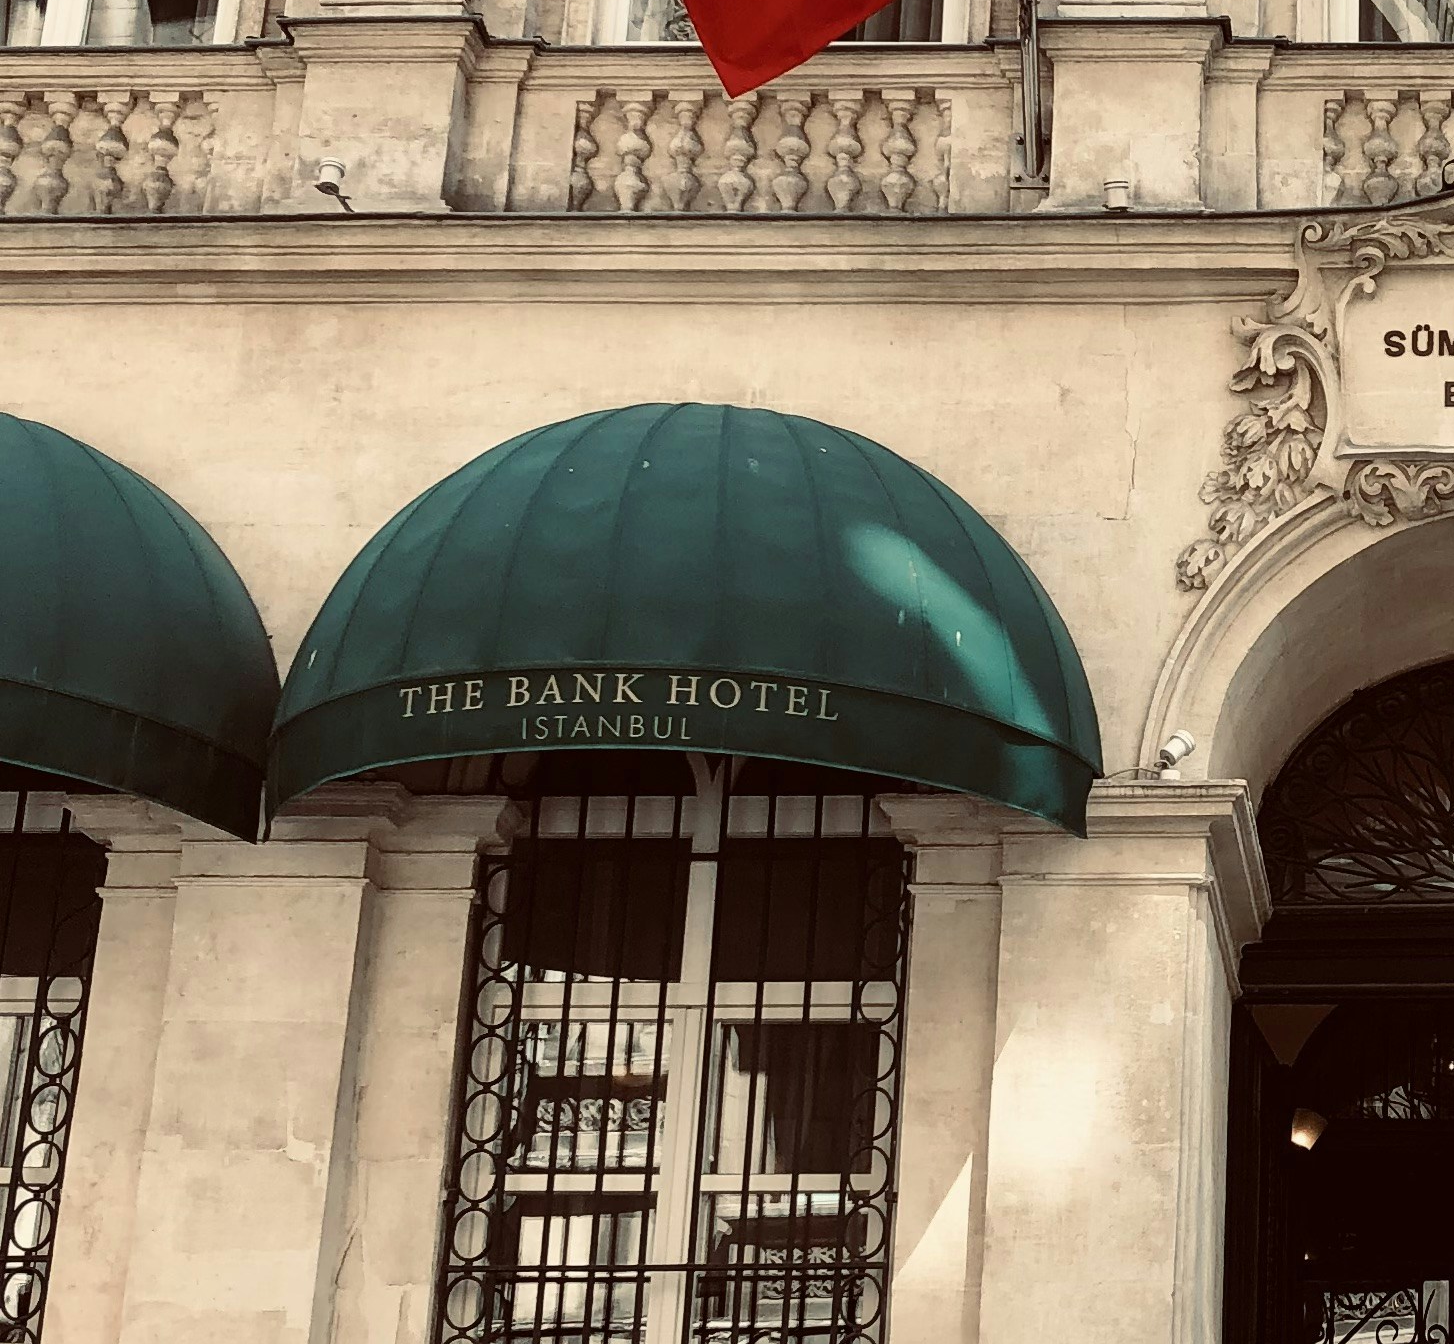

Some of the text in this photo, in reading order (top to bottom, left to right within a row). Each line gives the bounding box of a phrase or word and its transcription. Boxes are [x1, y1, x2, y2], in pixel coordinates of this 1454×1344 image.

[400, 672, 840, 722] THE BANK HOTEL
[521, 713, 692, 740] ISTANBUL
